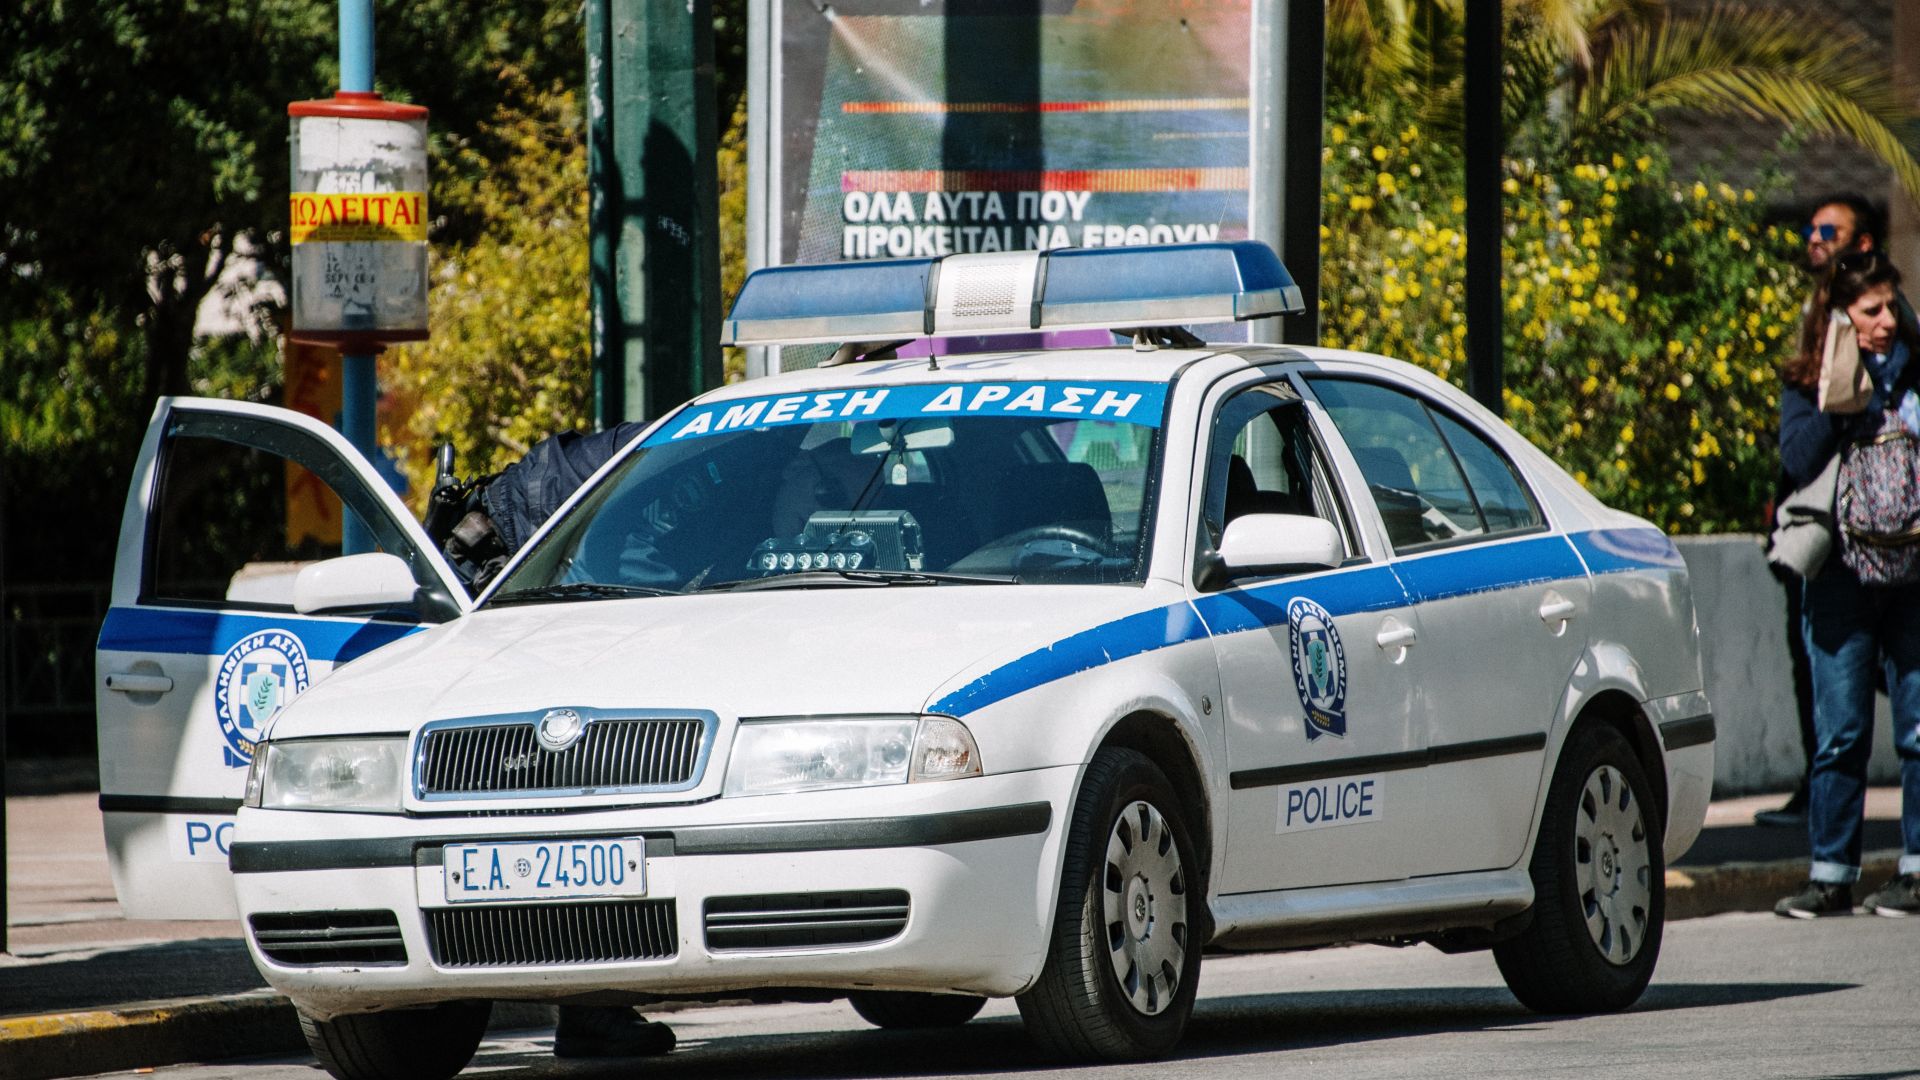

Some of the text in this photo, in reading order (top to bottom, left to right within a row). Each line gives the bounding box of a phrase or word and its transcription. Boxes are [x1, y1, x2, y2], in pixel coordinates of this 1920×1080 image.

[843, 190, 1092, 222] ΟΛΑ ΑΥΤΑ ΠΟΥ
[843, 224, 1013, 257] ΠΡΟΚΕΙΤΑΙ
[1025, 224, 1071, 251] ΝΑ
[672, 385, 1143, 440] ΑΜΕΣΗ ΔΡΑΣΗ
[1290, 601, 1346, 706] ΕΛΛΗΝΙΚΗ ΑΣΤΥΝΟΜΙΑ
[217, 634, 266, 735] ΕΛΛΗΝΙΚΗ
[1286, 780, 1375, 827] POLICE
[536, 842, 625, 888] 24500
